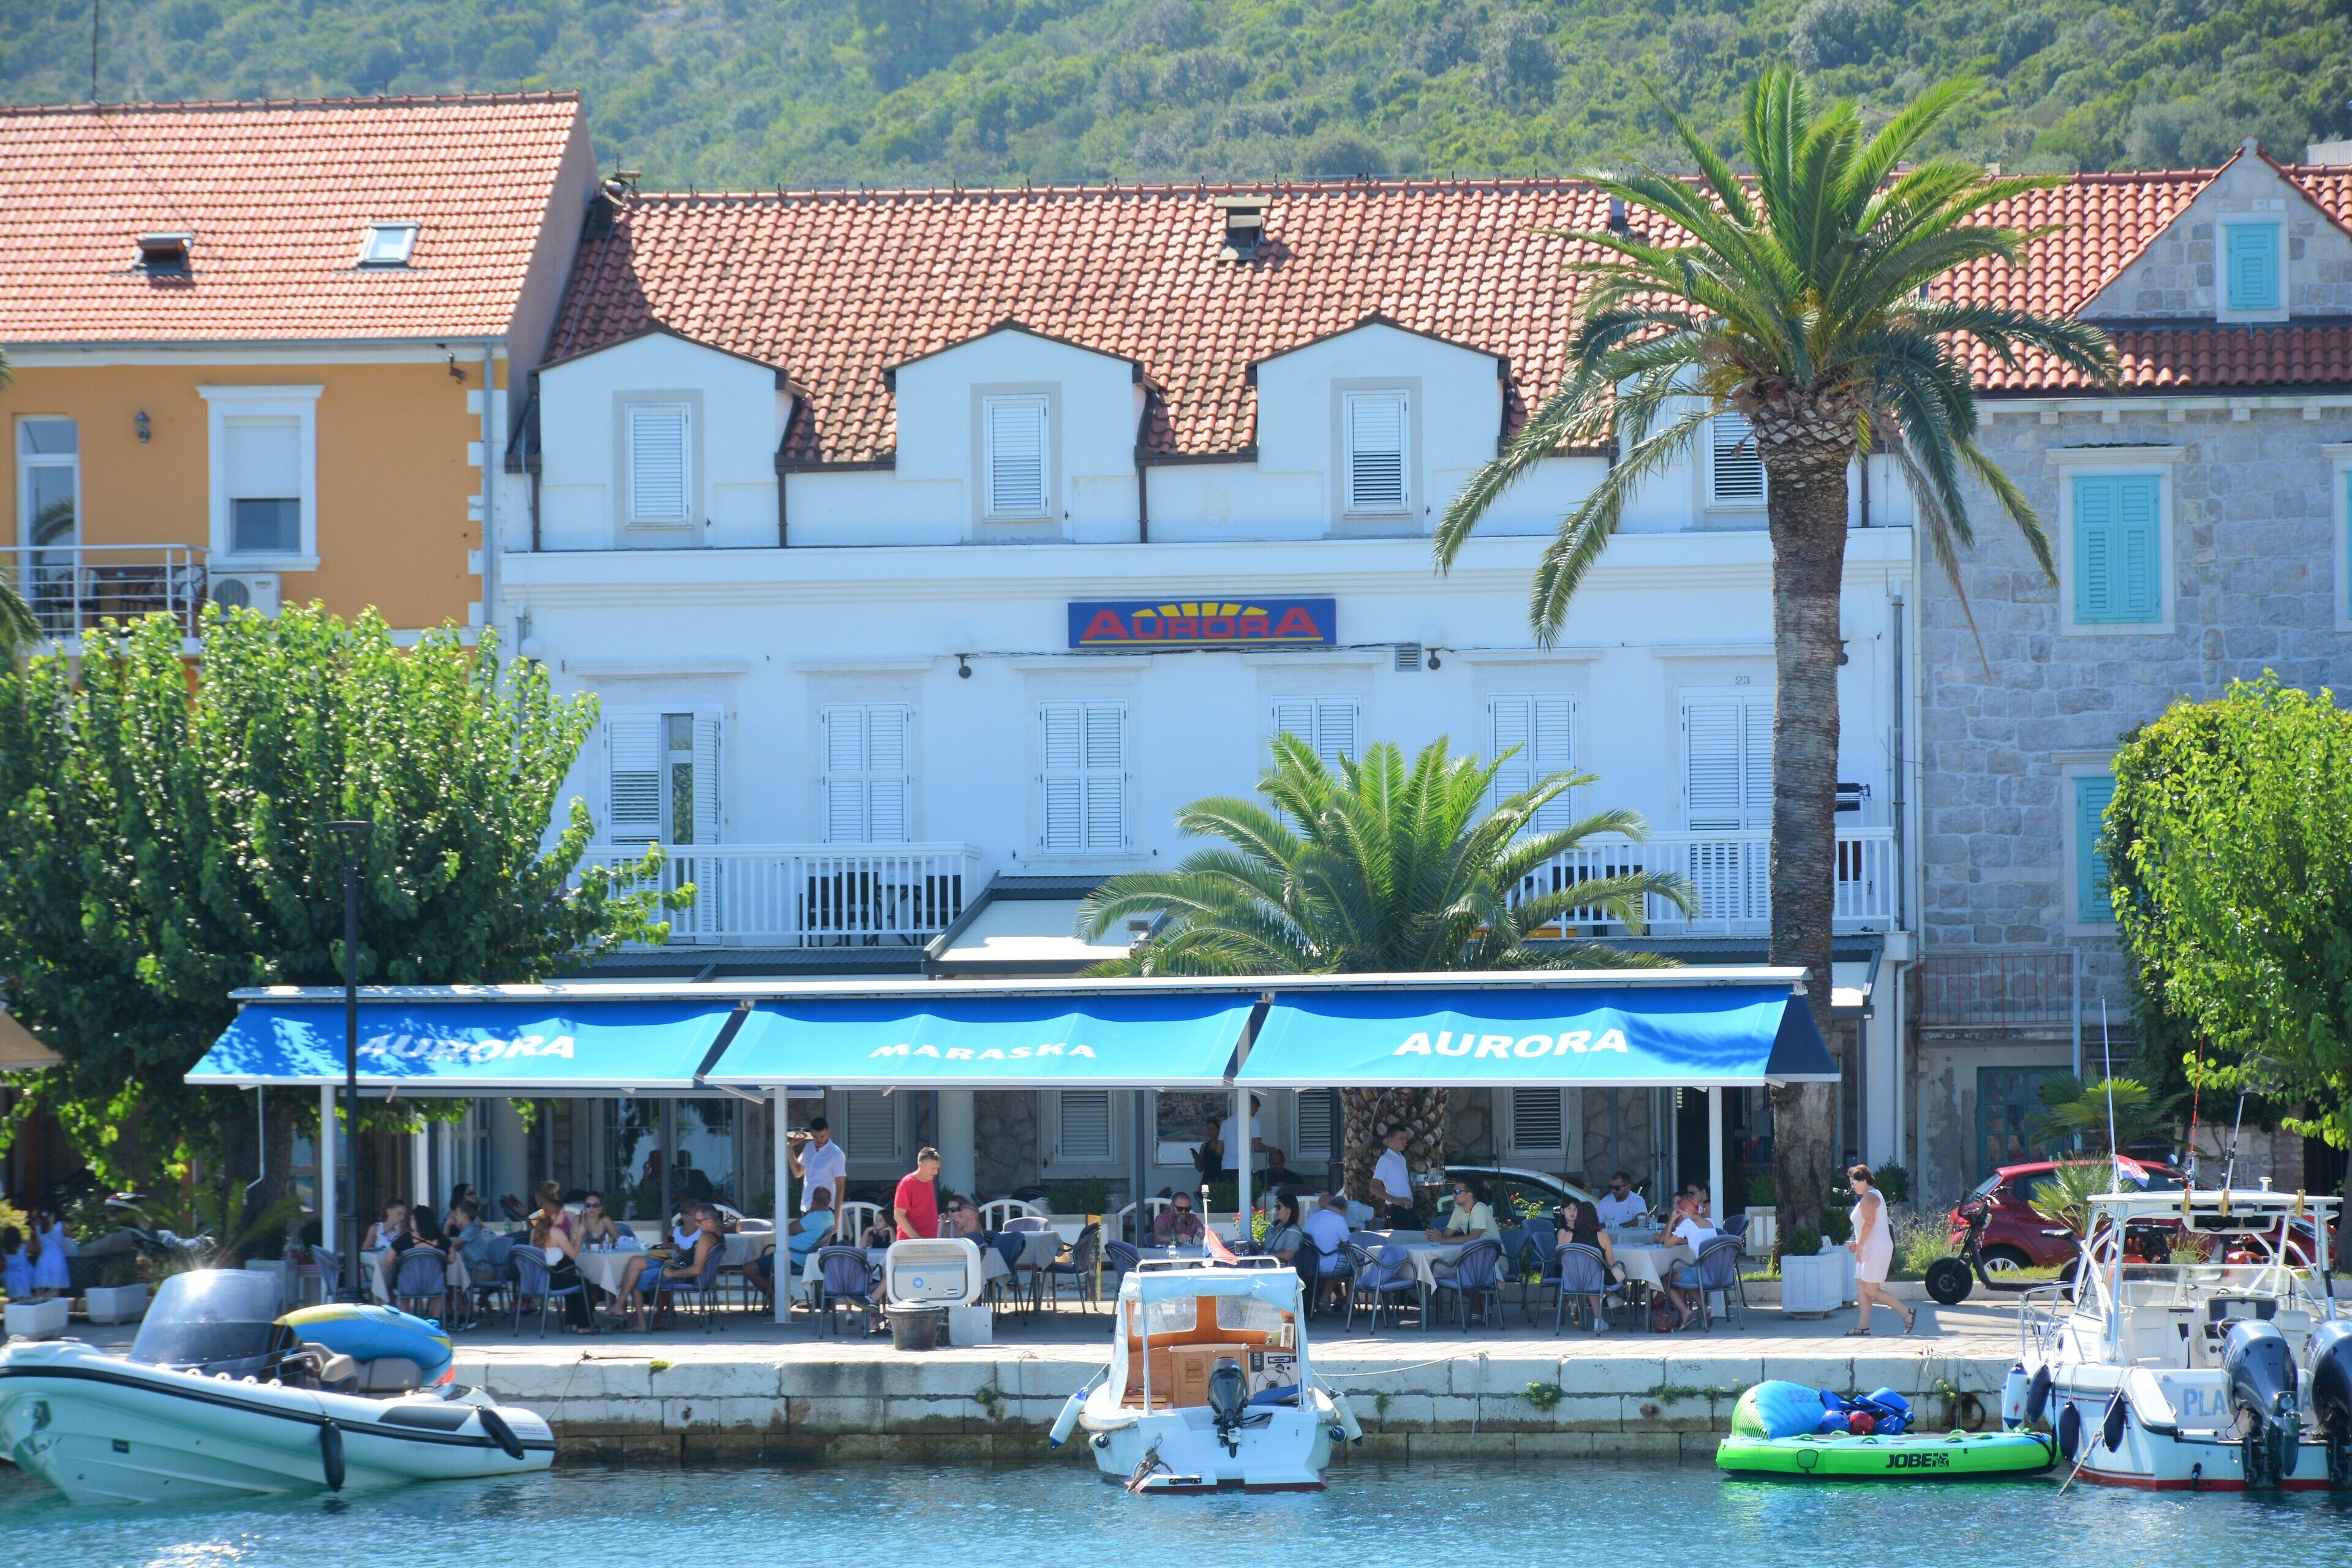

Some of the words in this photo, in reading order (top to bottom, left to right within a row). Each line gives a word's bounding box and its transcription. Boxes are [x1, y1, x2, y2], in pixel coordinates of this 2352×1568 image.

[1081, 608, 1322, 639] AURORA
[1735, 676, 1750, 685] 23
[356, 1035, 574, 1061] AURORA
[868, 1044, 1097, 1060] MARASKA
[1392, 1028, 1629, 1058] AURORA
[1885, 1453, 1932, 1468] JOBE
